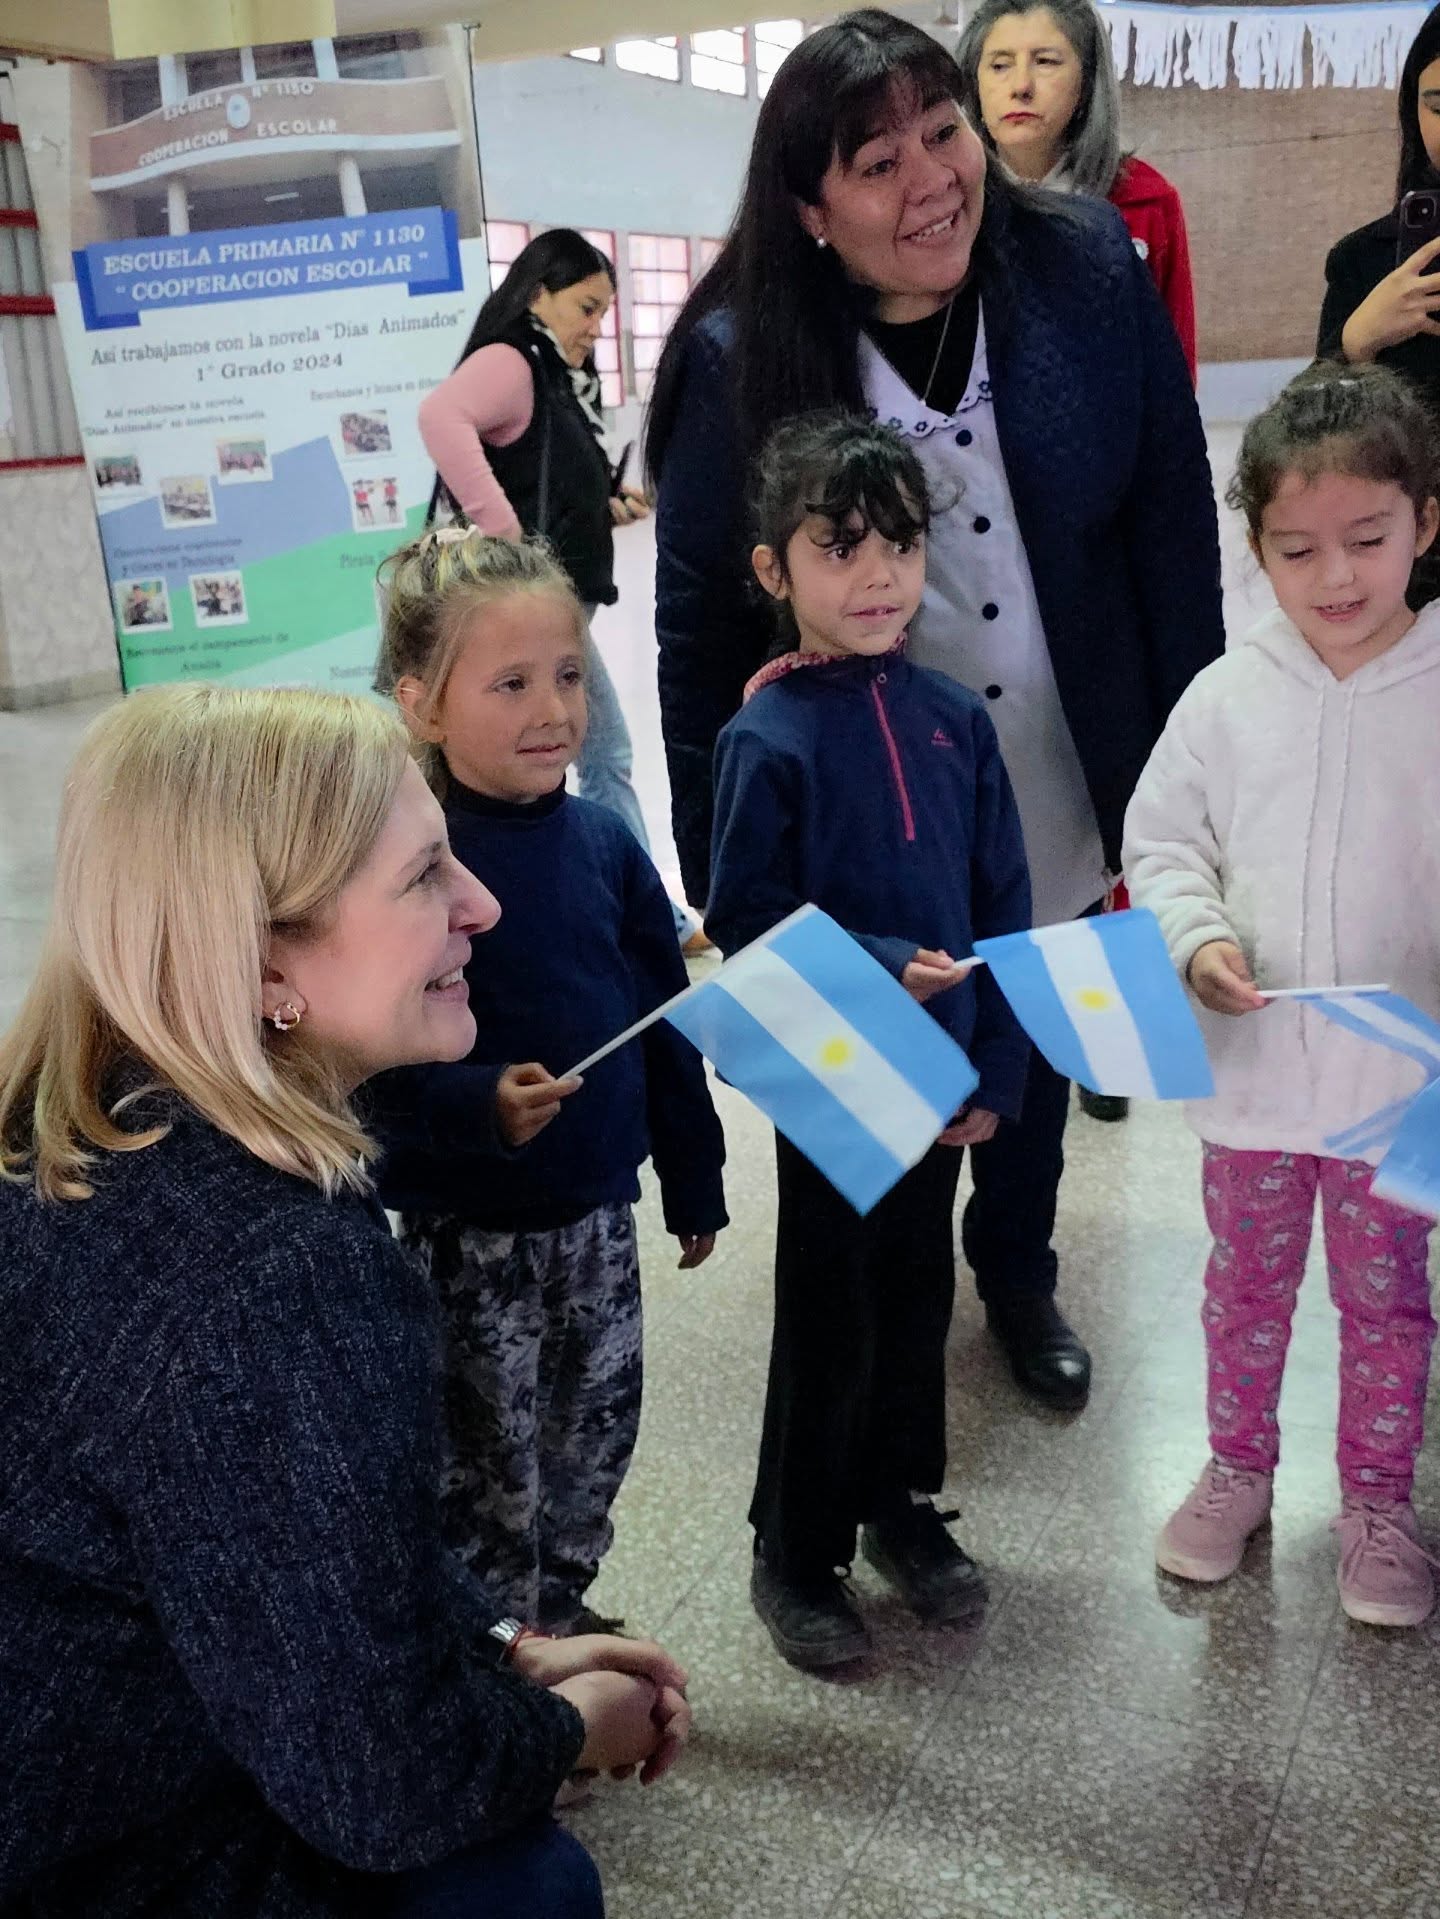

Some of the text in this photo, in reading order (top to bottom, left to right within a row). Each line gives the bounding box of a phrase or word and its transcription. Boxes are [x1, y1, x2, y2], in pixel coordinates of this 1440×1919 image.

[256, 119, 337, 137] ESCOLAR
[103, 249, 212, 275] ESCUELA
[219, 234, 334, 263] PRIMARIA
[131, 266, 299, 301] COOPERACION
[306, 254, 411, 284] ESCOLAR
[121, 339, 211, 364] trabajamos
[215, 337, 244, 352] con
[249, 330, 264, 348] la
[268, 325, 320, 347] novela
[221, 358, 286, 379] Grado
[293, 352, 344, 372] 2024
